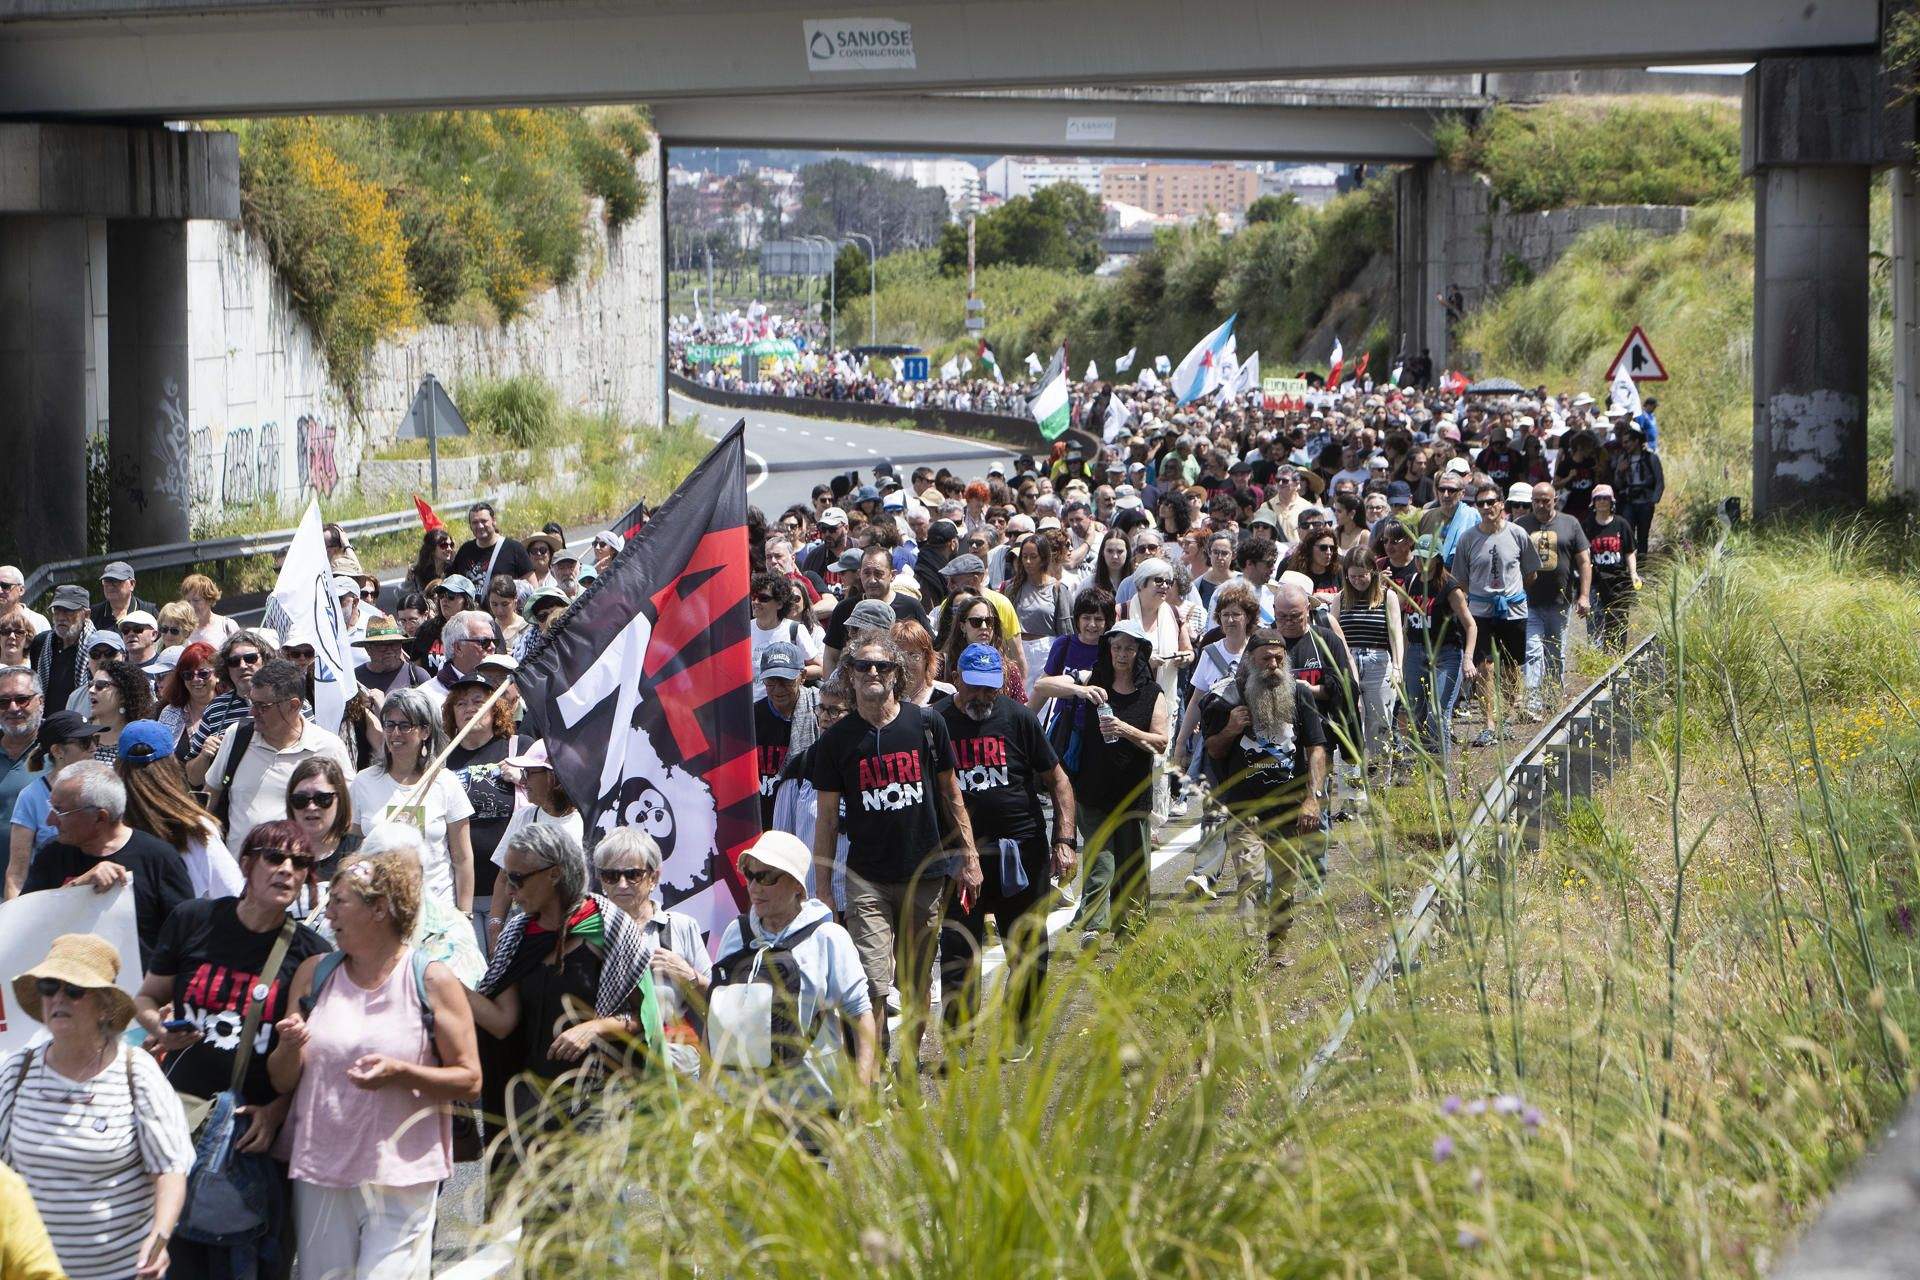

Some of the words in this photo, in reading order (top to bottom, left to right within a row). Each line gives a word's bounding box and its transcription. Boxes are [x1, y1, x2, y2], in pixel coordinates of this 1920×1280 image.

[836, 30, 910, 47] SANJOSE
[838, 48, 911, 58] CONSTRUCTORA
[858, 749, 923, 791] ALTRI
[861, 781, 924, 812] NON
